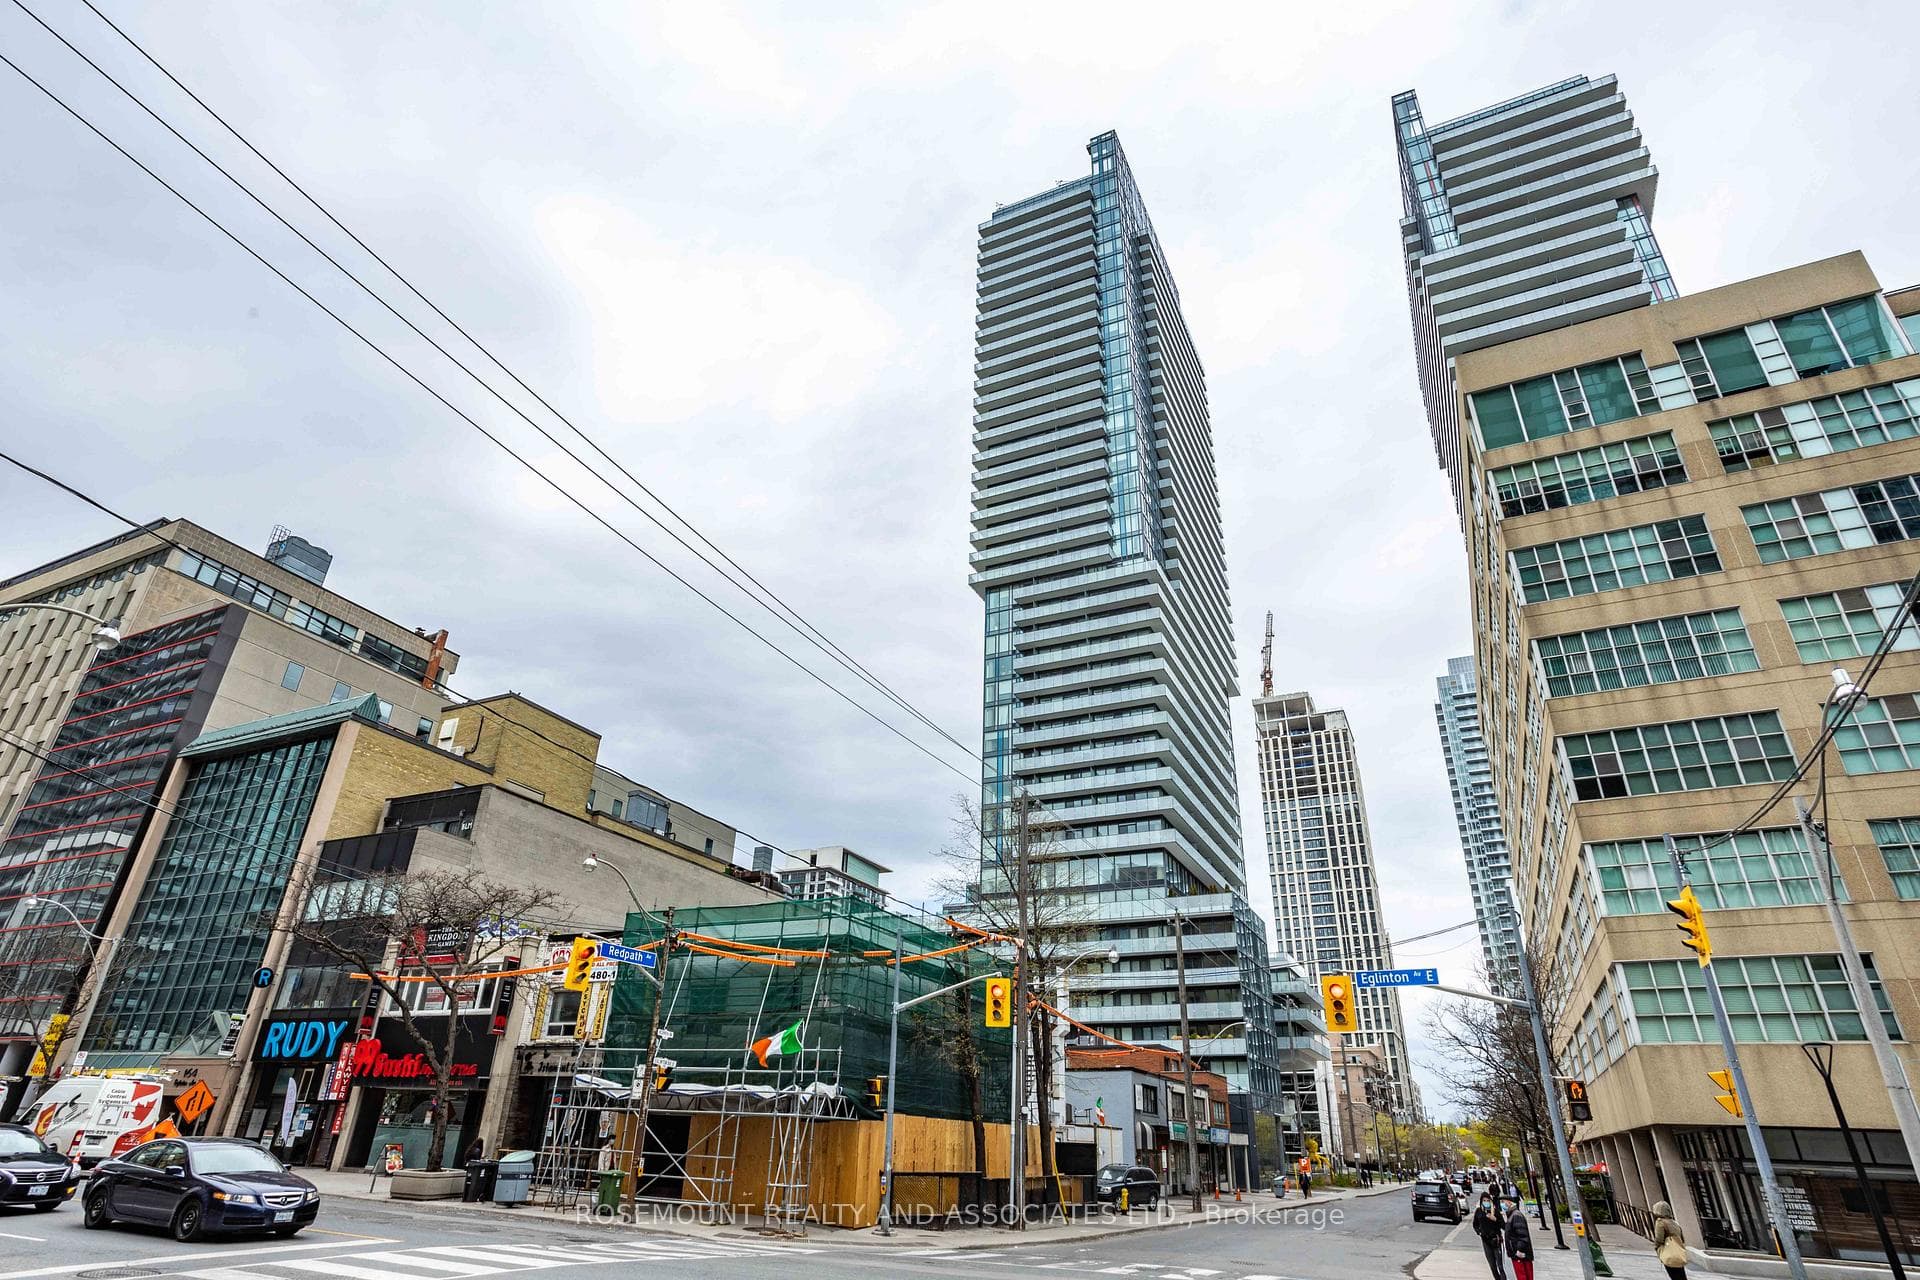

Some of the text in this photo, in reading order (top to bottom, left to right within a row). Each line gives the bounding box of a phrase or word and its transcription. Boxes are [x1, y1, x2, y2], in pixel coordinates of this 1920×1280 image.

[608, 945, 643, 962] Redpath
[258, 969, 271, 985] R
[1361, 972, 1409, 987] Eglinton
[1426, 970, 1434, 982] E
[262, 1020, 348, 1058] RUDY
